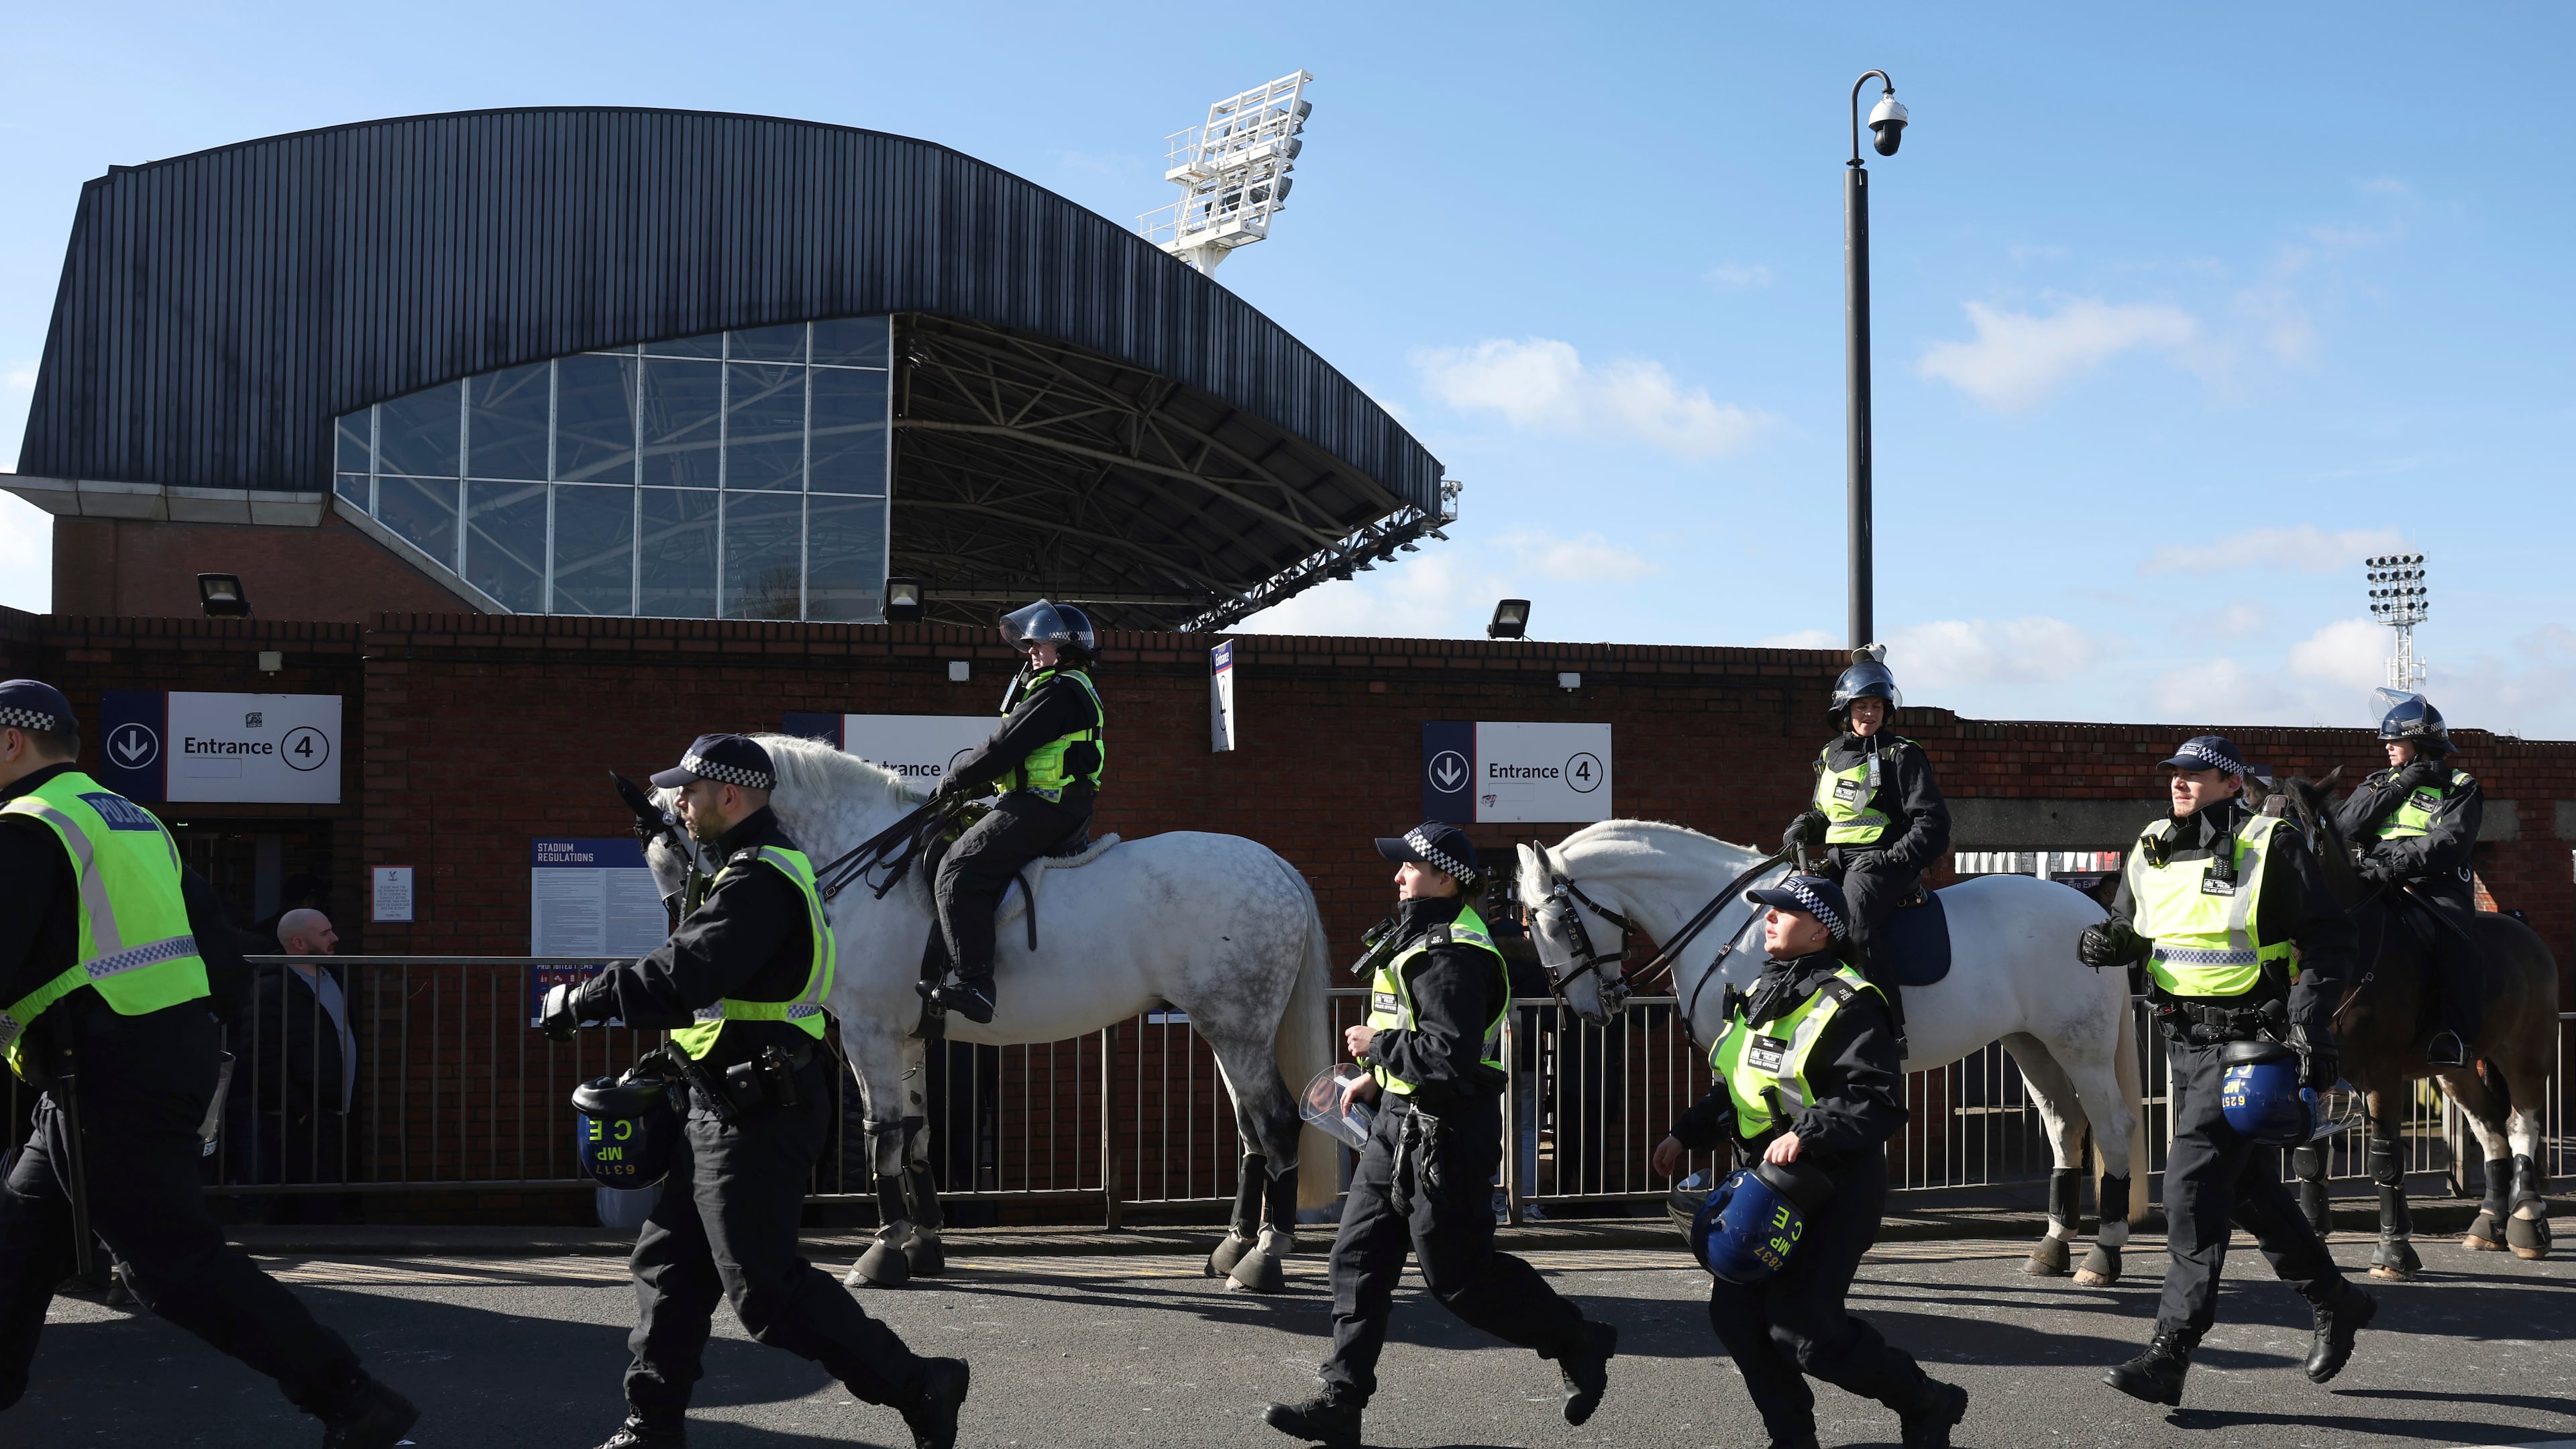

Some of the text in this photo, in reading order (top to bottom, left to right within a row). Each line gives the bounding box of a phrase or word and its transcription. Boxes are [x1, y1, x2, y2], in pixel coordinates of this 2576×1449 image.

[1216, 651, 1230, 667] Entrance
[184, 736, 313, 757] Entrance 4
[861, 759, 941, 776] trance
[1489, 761, 1591, 782] Entrance 4
[537, 843, 574, 852] STADIUM
[537, 853, 594, 862] REGULATIONS
[2068, 881, 2096, 889] Fire Exit
[2224, 1081, 2241, 1094] MP
[589, 1120, 632, 1140] C E
[597, 1146, 623, 1161] MP
[595, 1165, 635, 1175] 6317
[1770, 1236, 1790, 1256] MP
[1754, 1246, 1783, 1271] 2837
